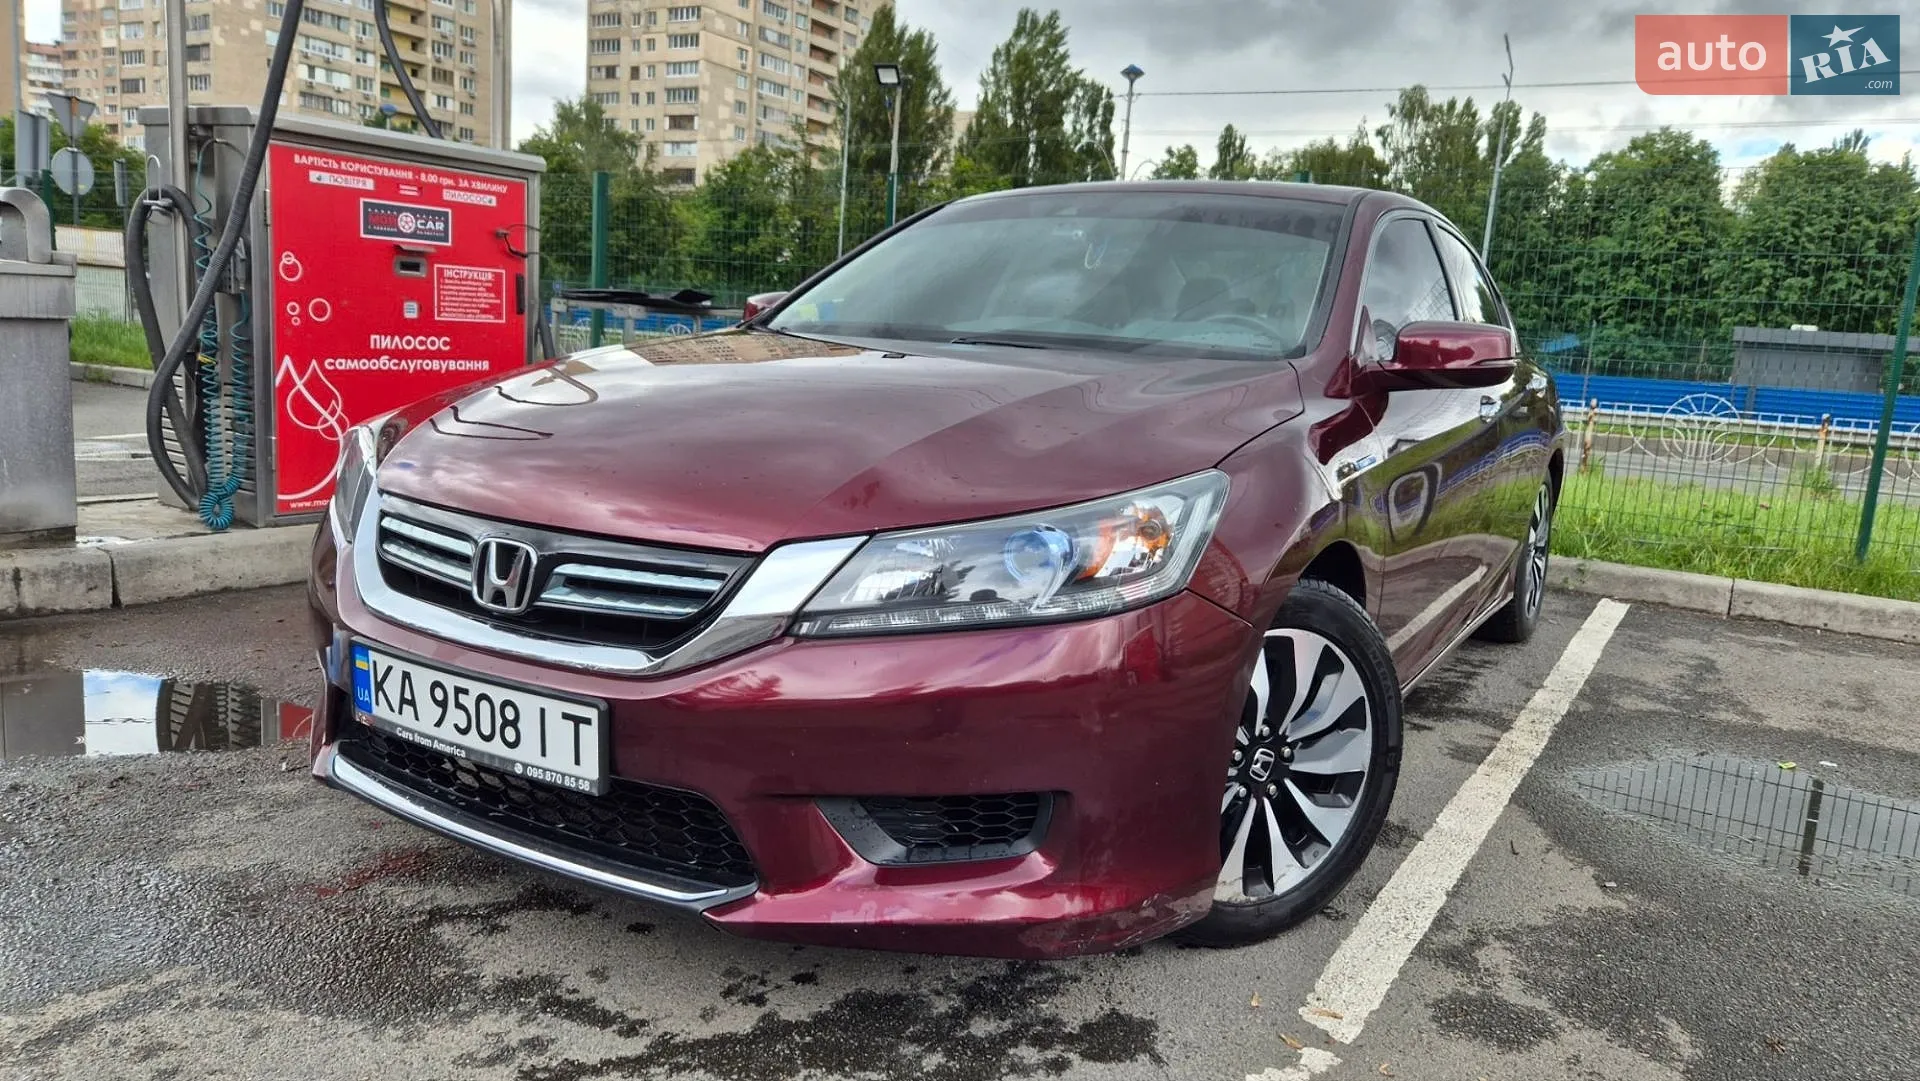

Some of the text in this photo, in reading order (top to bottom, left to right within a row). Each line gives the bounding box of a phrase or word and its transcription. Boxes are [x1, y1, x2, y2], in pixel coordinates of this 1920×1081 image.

[293, 153, 339, 169] ВАРТІСТЬ
[340, 161, 413, 179] КОРИСТУВАННЯ
[458, 178, 470, 188] ЗА
[471, 180, 508, 194] ХВИЛИНУ
[445, 190, 488, 203] ПИЛОСОС
[416, 219, 445, 231] CAR
[370, 334, 451, 351] ПИЛОСОС
[324, 355, 490, 374] самообслуговування
[357, 686, 370, 703] UA
[372, 659, 592, 766] KA 9508 IT
[396, 727, 466, 758] Cars from America
[526, 766, 544, 780] 095
[545, 770, 562, 785] 870
[564, 775, 576, 788] 85
